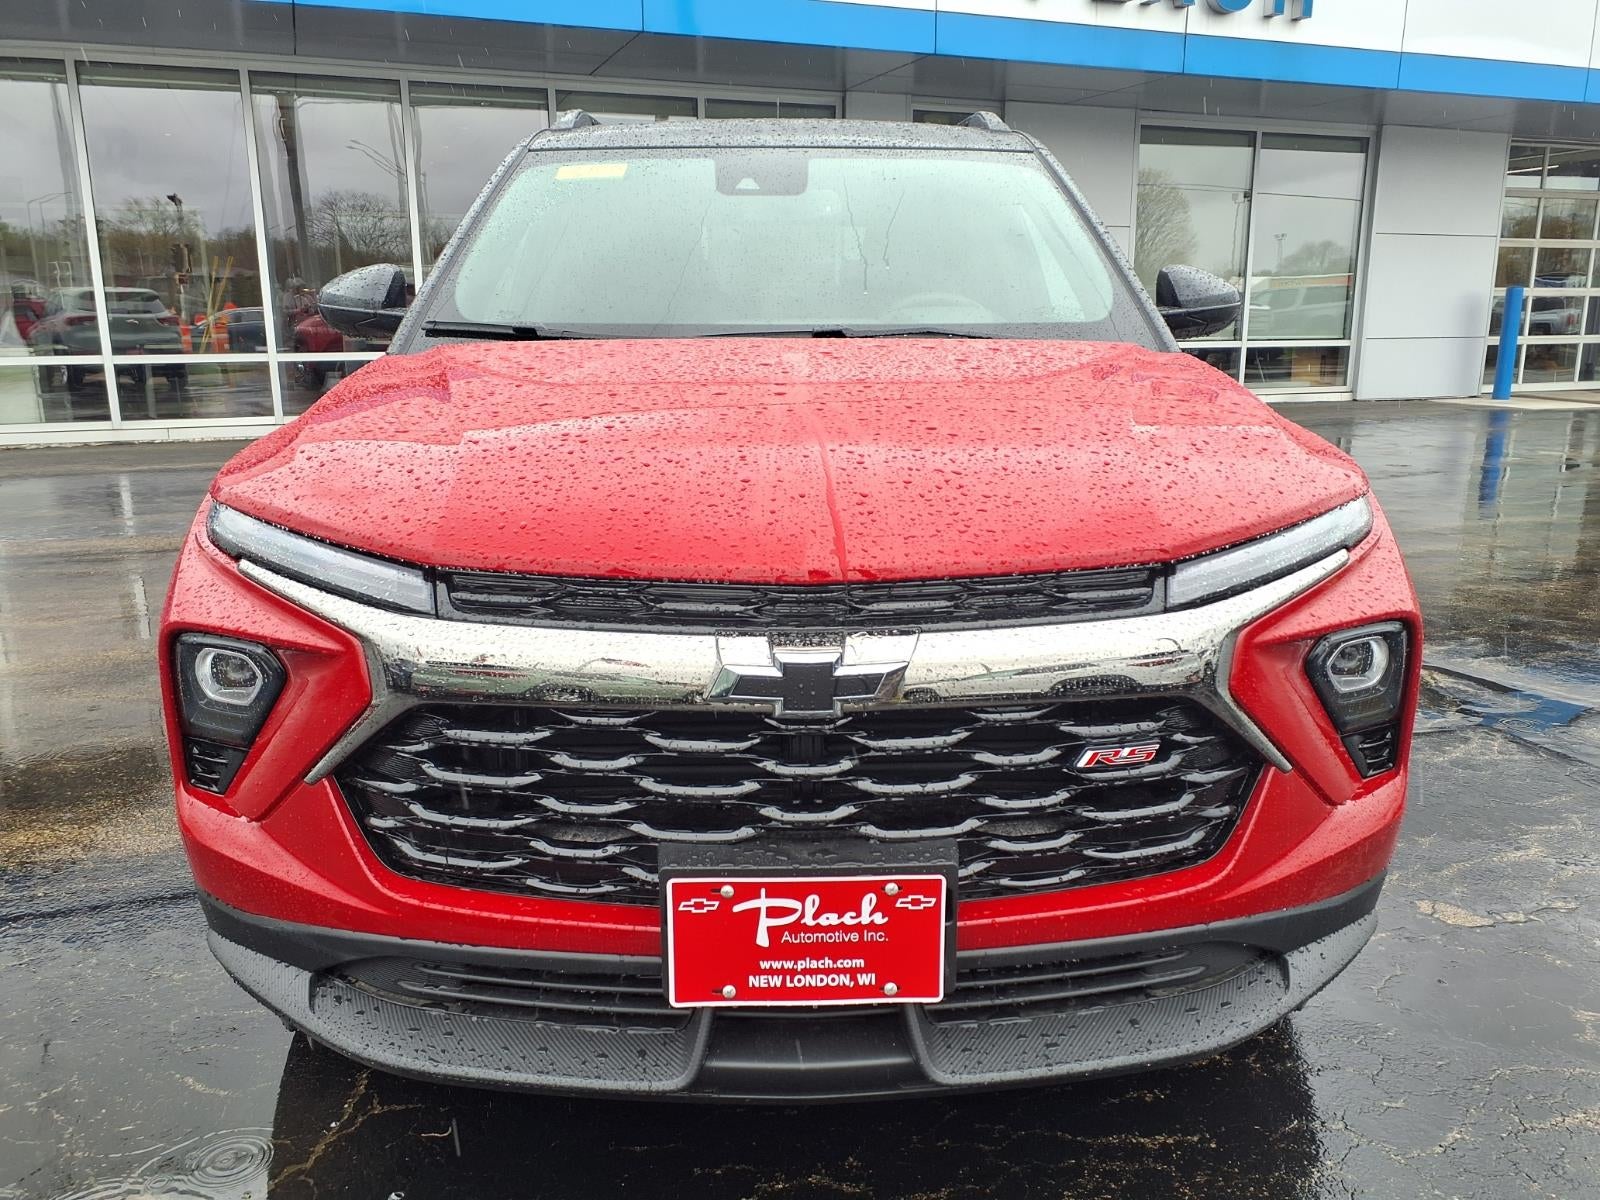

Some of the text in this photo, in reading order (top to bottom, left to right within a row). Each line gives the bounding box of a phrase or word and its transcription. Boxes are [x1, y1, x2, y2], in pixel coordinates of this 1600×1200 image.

[1077, 744, 1160, 768] RS
[732, 888, 888, 948] Plach
[781, 930, 889, 944] Automotive Inc.
[759, 957, 865, 971] www.plach.com
[748, 973, 876, 988] NEW LONDON, WI
